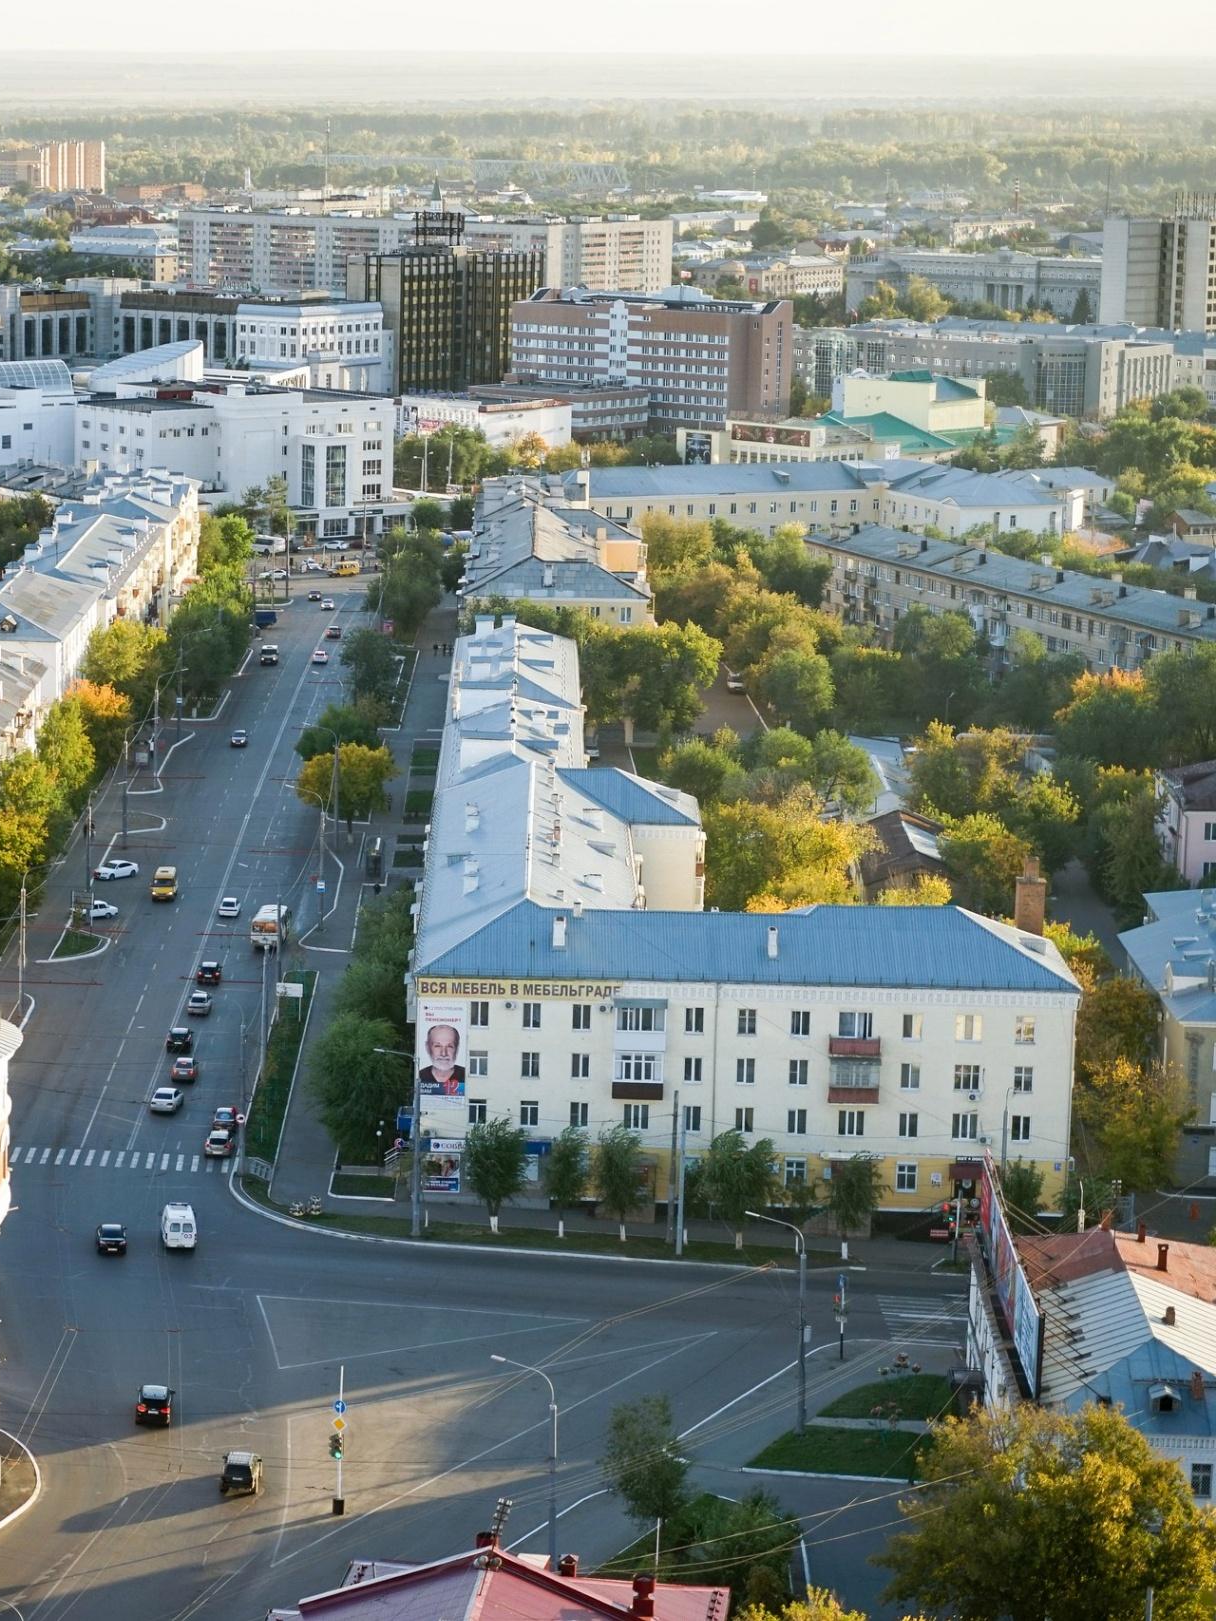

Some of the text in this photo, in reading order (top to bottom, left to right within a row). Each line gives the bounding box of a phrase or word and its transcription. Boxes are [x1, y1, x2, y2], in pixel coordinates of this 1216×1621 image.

[420, 981, 621, 998] ВСЯ МЕБЕЛЬ В МЕБЕЛЬГРАДЕ
